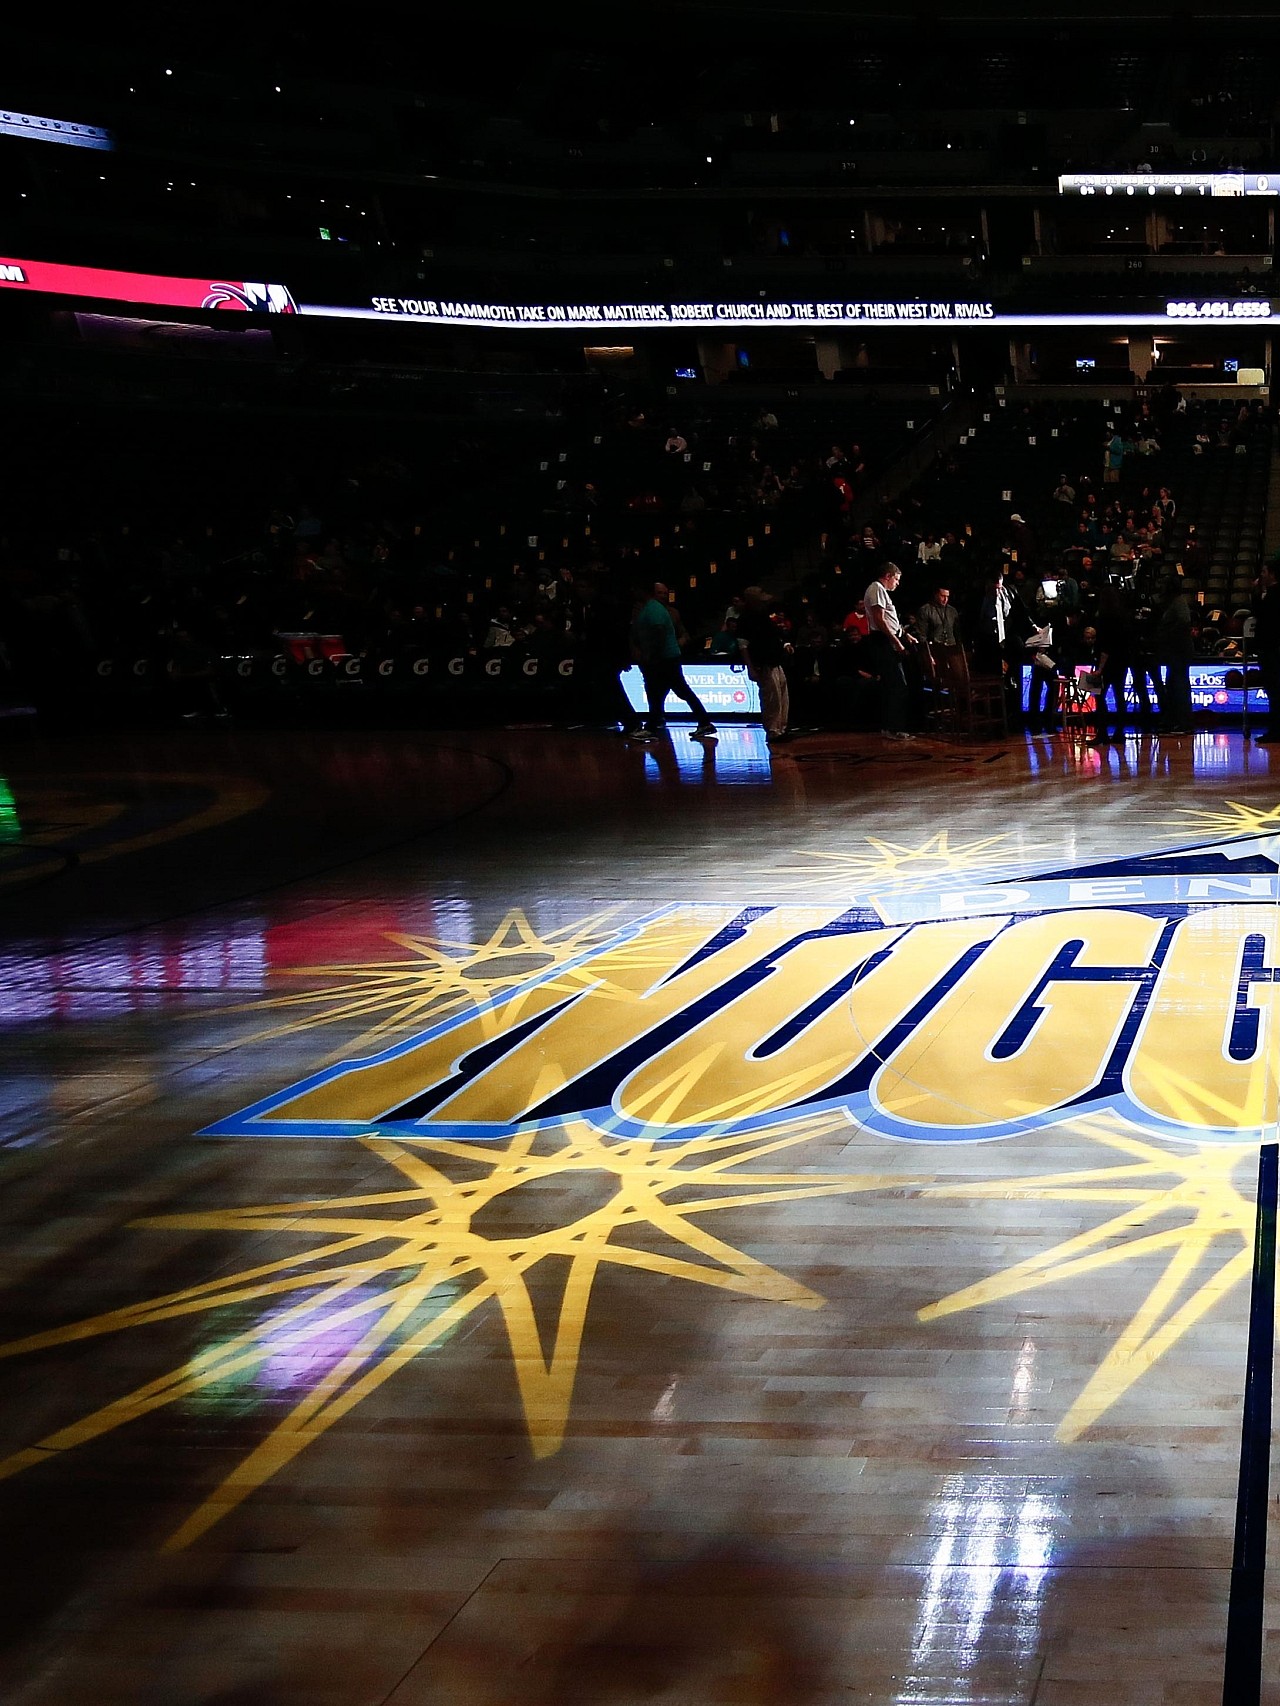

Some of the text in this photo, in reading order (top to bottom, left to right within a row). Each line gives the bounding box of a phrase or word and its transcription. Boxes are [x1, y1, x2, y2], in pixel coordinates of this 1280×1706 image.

[0, 264, 25, 282] M
[1127, 261, 1143, 269] 260
[372, 297, 994, 321] SEE YOUR MAMMOTH TAKE ON MARK MATTHEWS, ROBERT CHURCH AND THE REST OF THEIR WEST DIV. RIVALS
[345, 659, 360, 675] G
[379, 659, 394, 675] G
[413, 659, 429, 675] G
[448, 658, 464, 674] G
[485, 659, 501, 675] G
[523, 659, 538, 675] G
[558, 659, 574, 675] G
[686, 674, 714, 685] NVER
